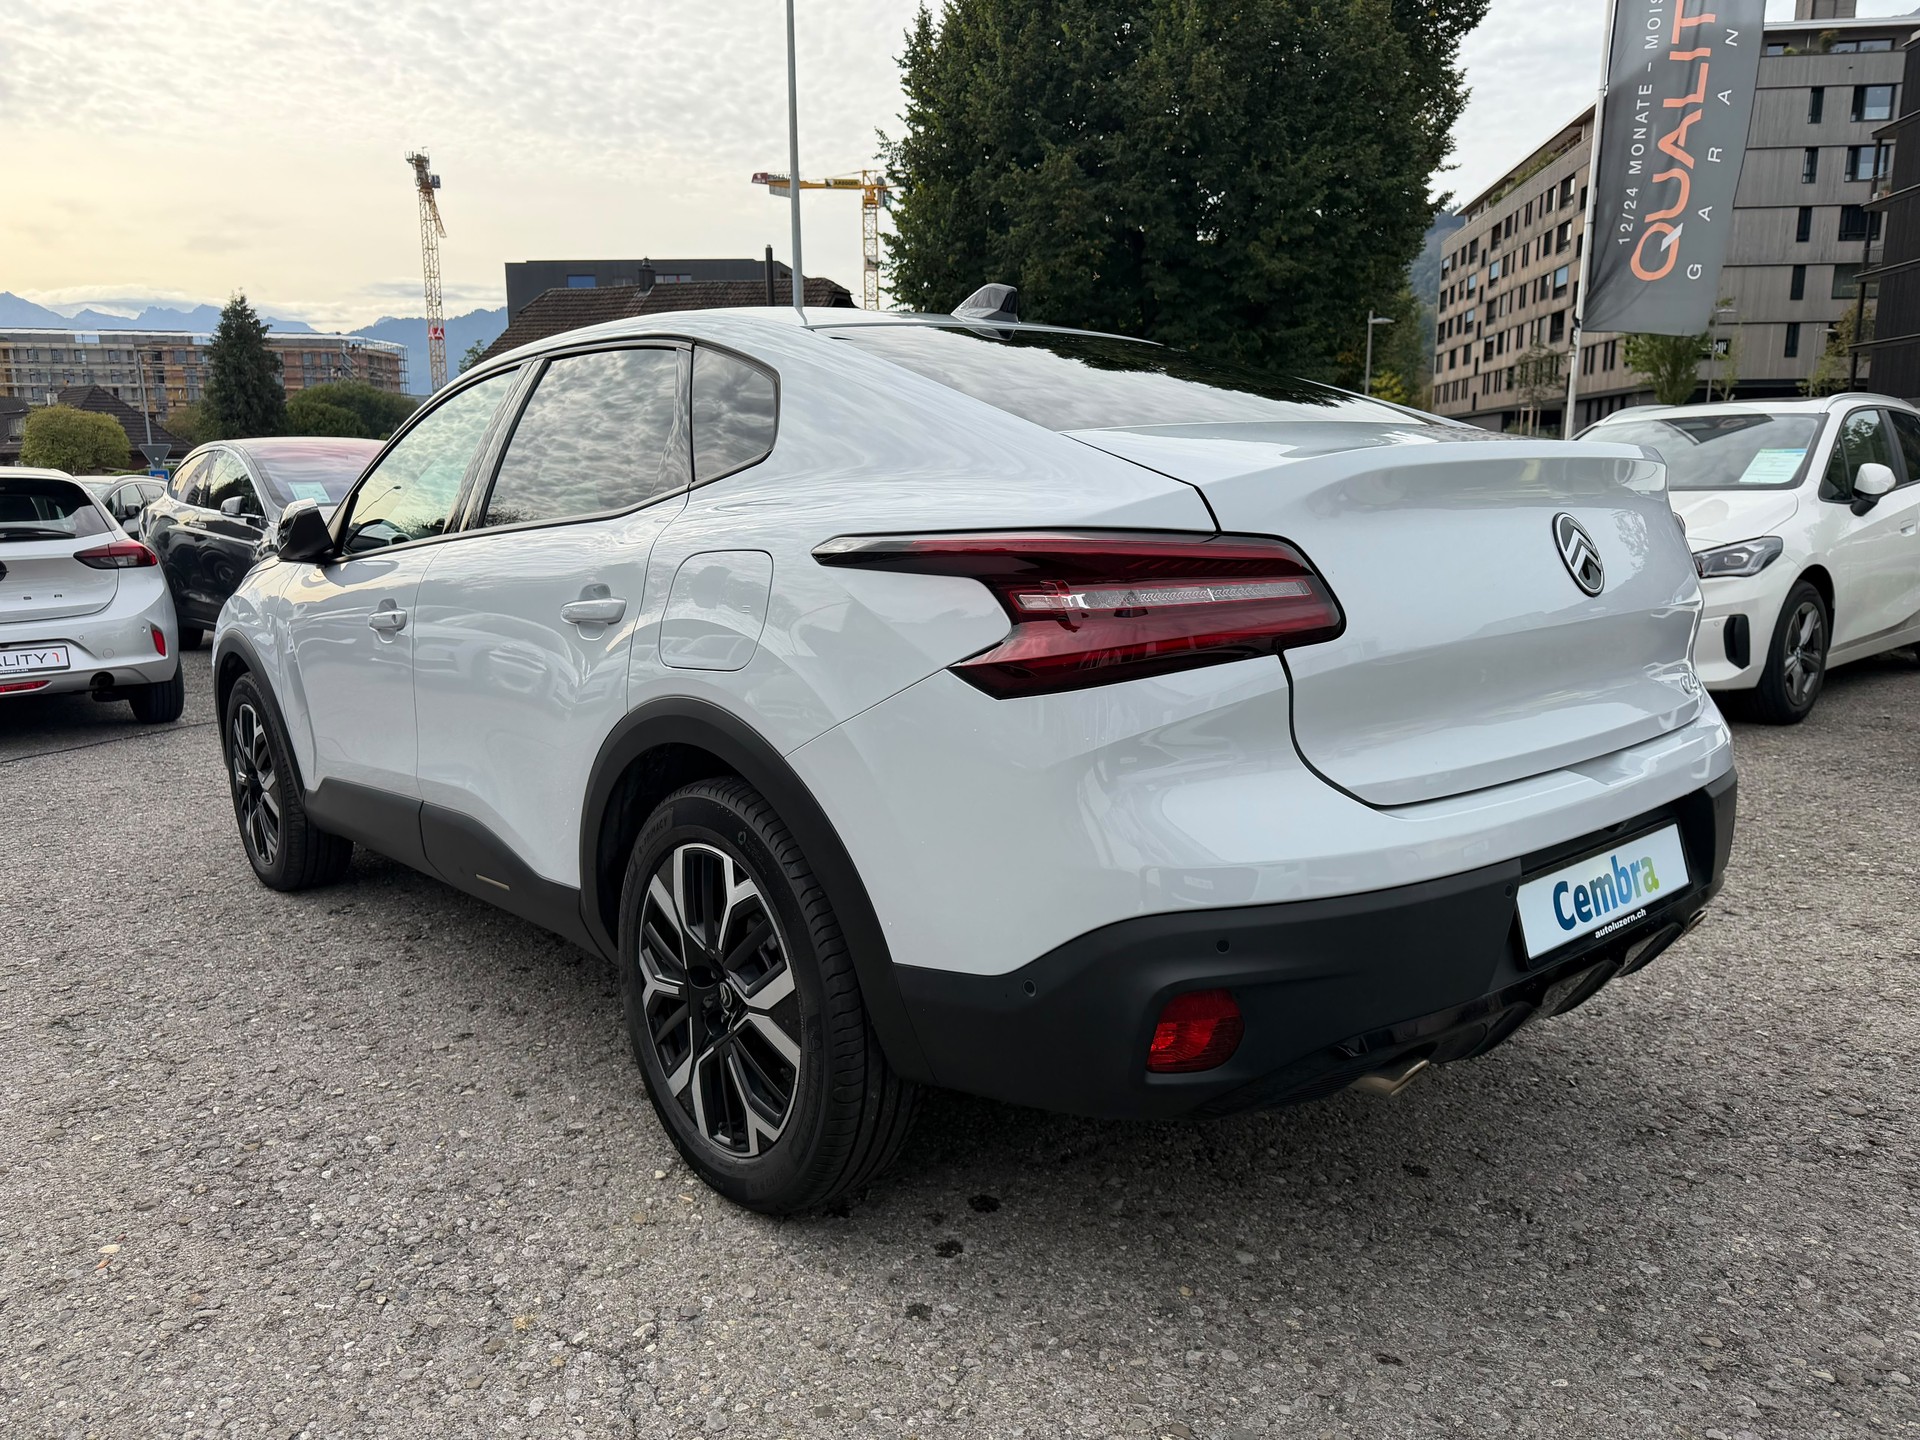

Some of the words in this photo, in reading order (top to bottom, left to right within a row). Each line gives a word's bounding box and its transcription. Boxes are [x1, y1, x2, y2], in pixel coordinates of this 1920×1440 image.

[1617, 187, 1638, 244] 12/24
[1629, 84, 1653, 174] MONATE
[0, 652, 47, 667] LITY
[1552, 854, 1660, 931] Cembra
[1594, 908, 1647, 939] autoluzern.ch
